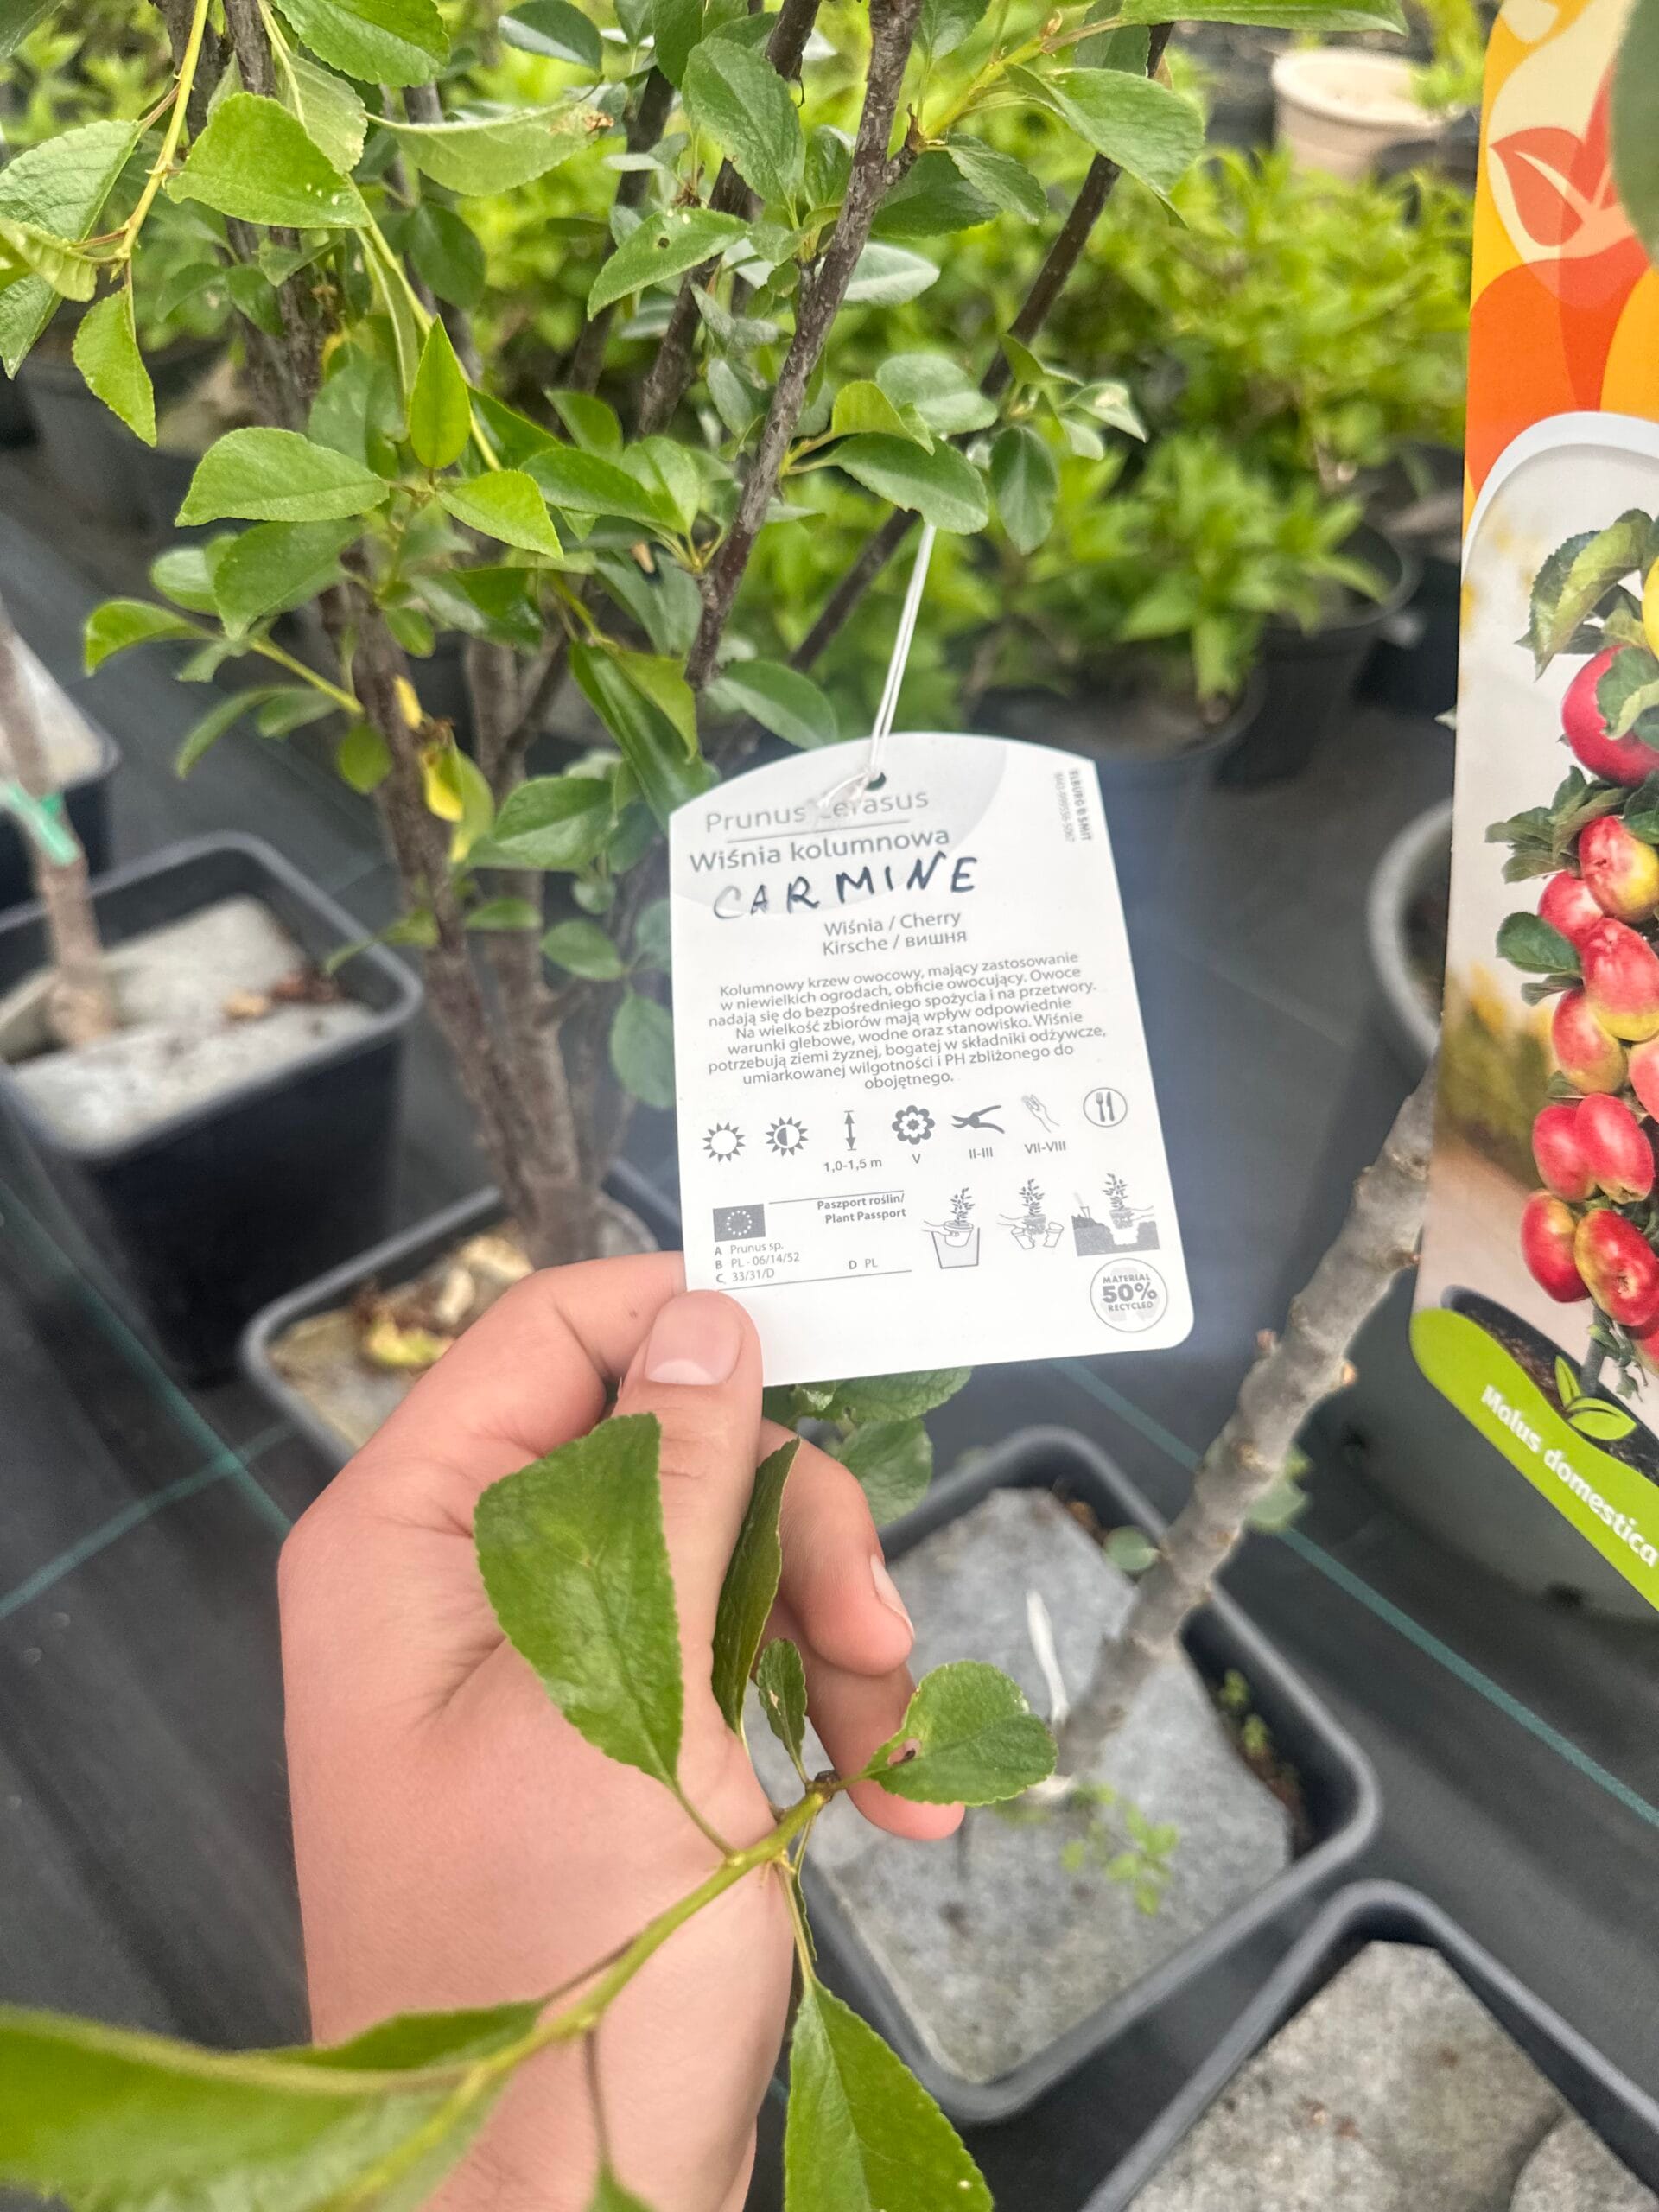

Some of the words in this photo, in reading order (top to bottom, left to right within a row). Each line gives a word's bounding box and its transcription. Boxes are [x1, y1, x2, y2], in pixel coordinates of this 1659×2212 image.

[706, 806, 805, 833] Prunus
[1077, 817, 1092, 841] SMIT
[690, 847, 780, 873] Wiśnia
[791, 830, 949, 861] kolumnowa
[714, 851, 977, 919] CARMINE
[825, 918, 883, 937] Wiśnia
[889, 917, 896, 932] /
[900, 912, 962, 930] Cherry
[823, 936, 887, 956] Kirsche
[893, 936, 899, 950] /
[906, 931, 967, 948] вишня
[720, 981, 804, 996] Kolumnowy
[808, 976, 850, 988] krzew
[853, 969, 925, 985] owocowy,
[928, 963, 978, 977] mający
[982, 952, 1078, 972] zastosowanie
[721, 1001, 733, 1011] w
[736, 992, 816, 1010] niewielkich
[820, 984, 892, 1003] ogrodach,
[895, 979, 944, 995] obficie
[947, 973, 1027, 989] owocujący.
[1030, 968, 1081, 982] Owoce
[709, 1014, 756, 1027] nadają
[760, 1010, 779, 1024] się
[783, 1008, 802, 1020] do
[805, 998, 921, 1018] bezpośredniego
[925, 991, 986, 1008] spożycia
[989, 990, 993, 1000] i
[997, 989, 1015, 999] na
[1019, 982, 1096, 1000] przetwory.
[736, 1027, 754, 1039] Na
[759, 1021, 820, 1036] wielkość
[823, 1016, 880, 1032] zbiorów
[885, 1013, 920, 1027] mają
[924, 1007, 971, 1022] wpływ
[976, 997, 1071, 1018] odpowiednie
[728, 1039, 785, 1055] warunki
[789, 1033, 855, 1052] glebowe,
[858, 1029, 908, 1043] wodne
[912, 1026, 944, 1038] oraz
[947, 1018, 1033, 1035] stanowisko.
[1033, 1011, 1083, 1027] Wiśnie
[709, 1054, 787, 1075] potrzebują
[791, 1051, 829, 1065] ziemi
[832, 1046, 881, 1062] żyznej,
[885, 1039, 941, 1058] bogatej
[944, 1040, 957, 1051] w
[962, 1032, 1026, 1050] składniki
[1029, 1026, 1106, 1044] odżywcze,
[743, 1064, 846, 1085] umiarkowanej
[849, 1056, 933, 1076] wilgotności
[937, 1055, 941, 1067] i
[945, 1053, 965, 1066] PH
[969, 1047, 1050, 1065] zbliżonego
[1054, 1044, 1073, 1056] do
[865, 1072, 954, 1090] obojętnego.
[912, 1154, 921, 1164] V
[969, 1147, 993, 1159] II-III
[1024, 1141, 1066, 1154] VII-VIII
[823, 1158, 867, 1173] 1,0-1,5
[871, 1159, 882, 1167] m
[817, 1197, 866, 1211] Paszport
[869, 1193, 905, 1205] roślin/
[825, 1211, 855, 1224] Plant
[857, 1209, 906, 1223] Passport
[715, 1246, 722, 1256] A
[730, 1243, 766, 1255] Prunus
[769, 1243, 784, 1253] sp.
[715, 1260, 722, 1269] B
[731, 1258, 744, 1268] PL
[753, 1252, 800, 1266] 06/14/52
[732, 1268, 775, 1282] 33/31/D
[849, 1260, 857, 1269] D
[864, 1258, 878, 1268] PL
[1103, 1273, 1150, 1284] MATERIAL
[1102, 1281, 1158, 1303] 50%
[1108, 1301, 1154, 1312] RECYCLED
[1482, 1385, 1542, 1453] Malus
[1544, 1449, 1659, 1567] domestica
